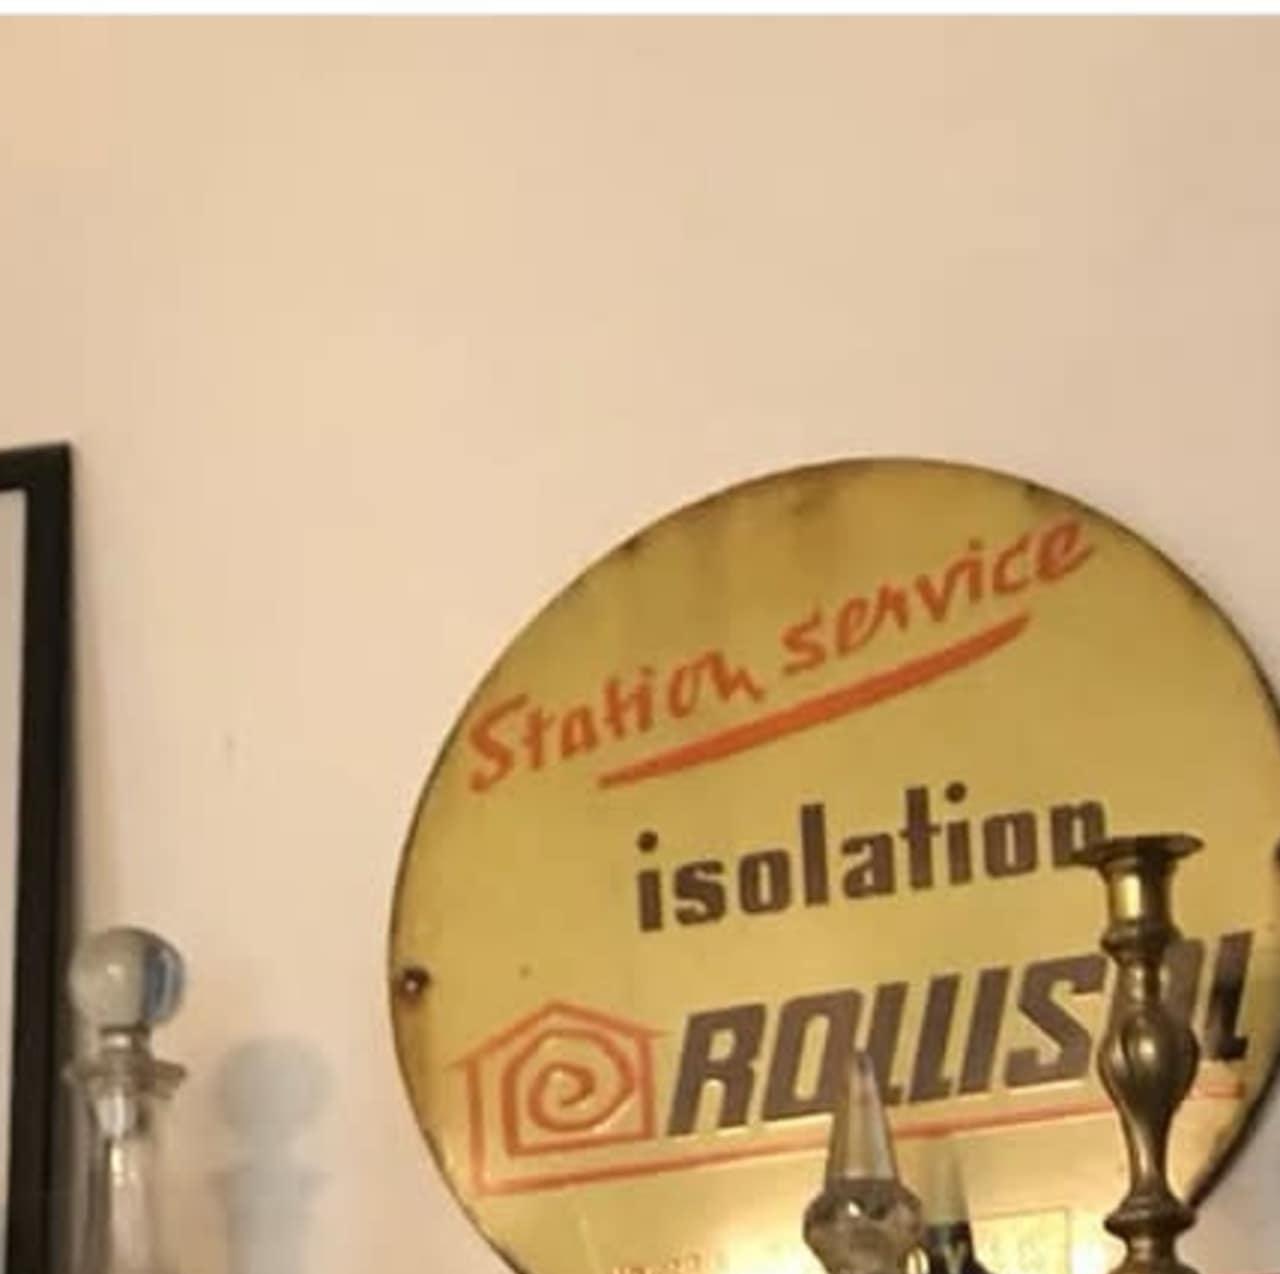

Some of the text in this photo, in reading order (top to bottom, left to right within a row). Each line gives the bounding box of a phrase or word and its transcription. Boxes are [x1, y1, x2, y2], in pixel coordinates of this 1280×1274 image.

[468, 517, 1096, 794] Station service
[637, 779, 1110, 933] isolation
